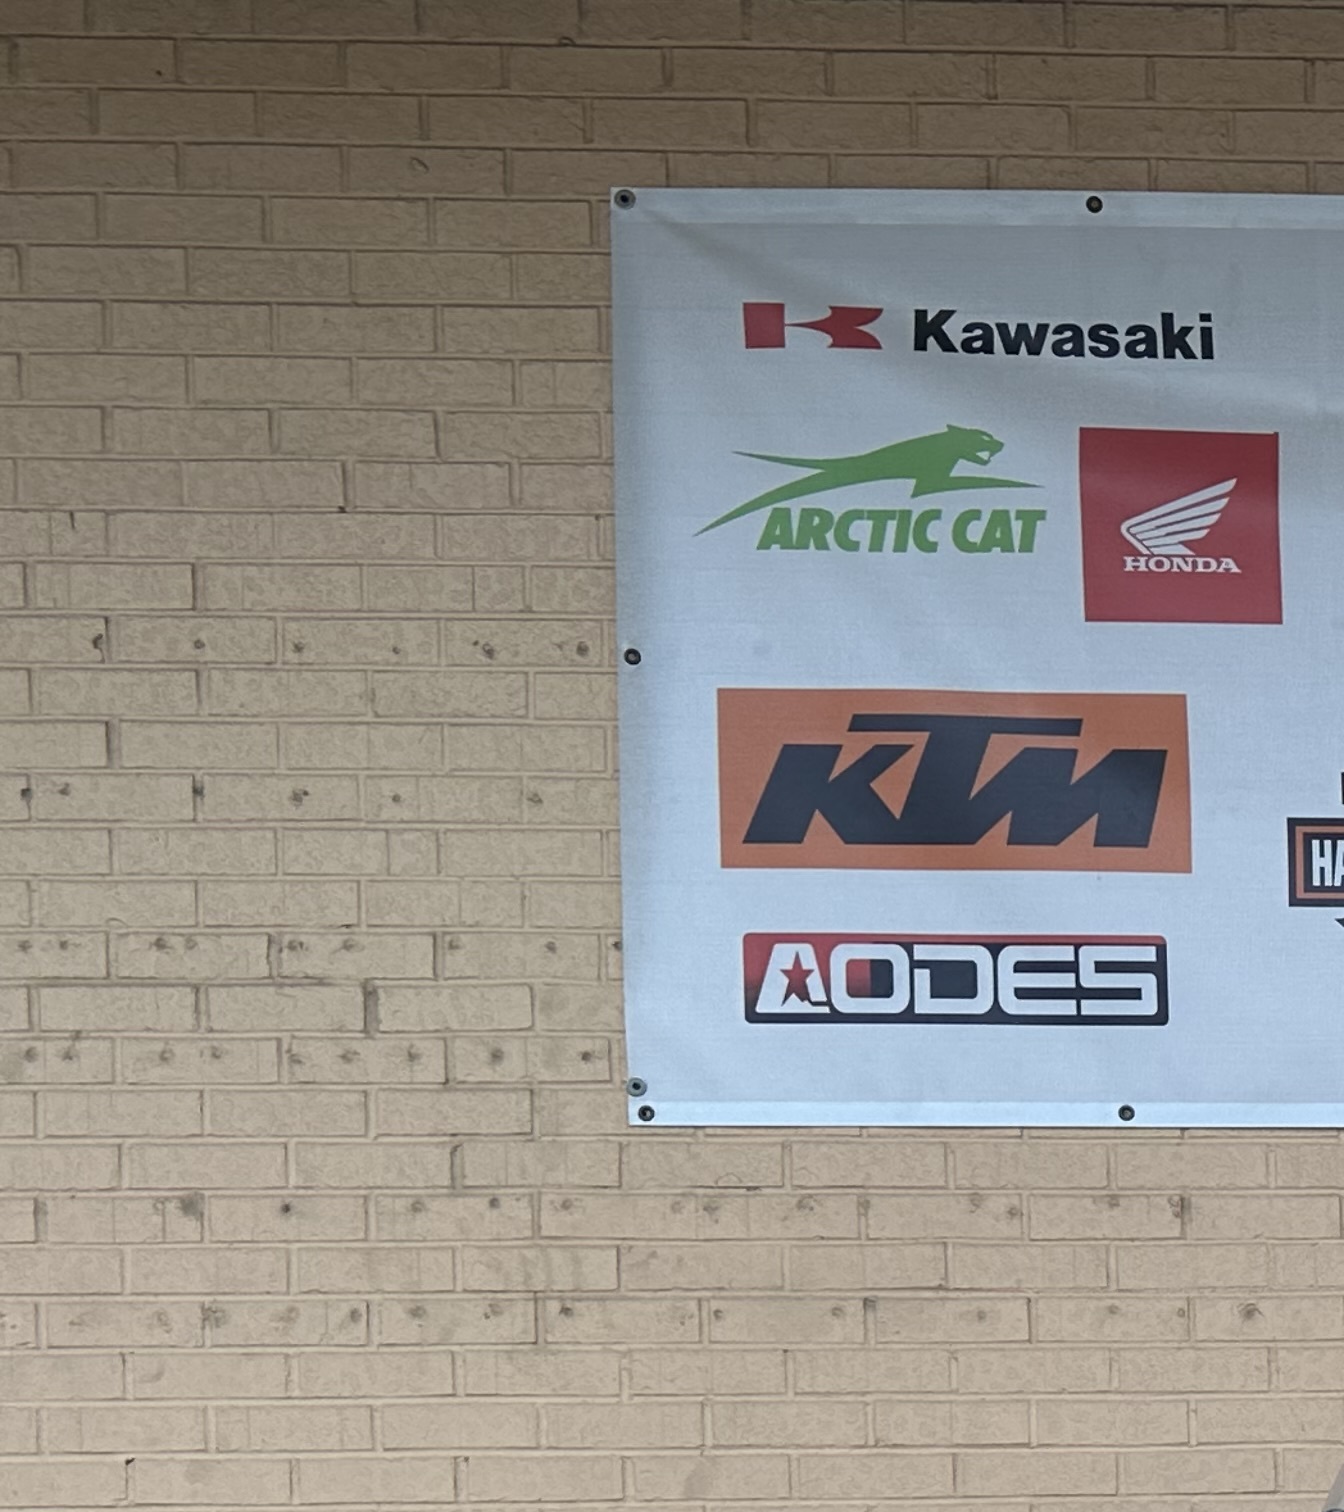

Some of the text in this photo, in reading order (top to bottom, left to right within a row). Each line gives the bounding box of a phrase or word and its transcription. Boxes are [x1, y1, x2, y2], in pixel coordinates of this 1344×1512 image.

[912, 309, 1216, 360] Kawasaki
[756, 508, 1047, 554] ARCTIC CAT
[1122, 556, 1242, 574] HONDA
[742, 713, 1169, 848] KTM
